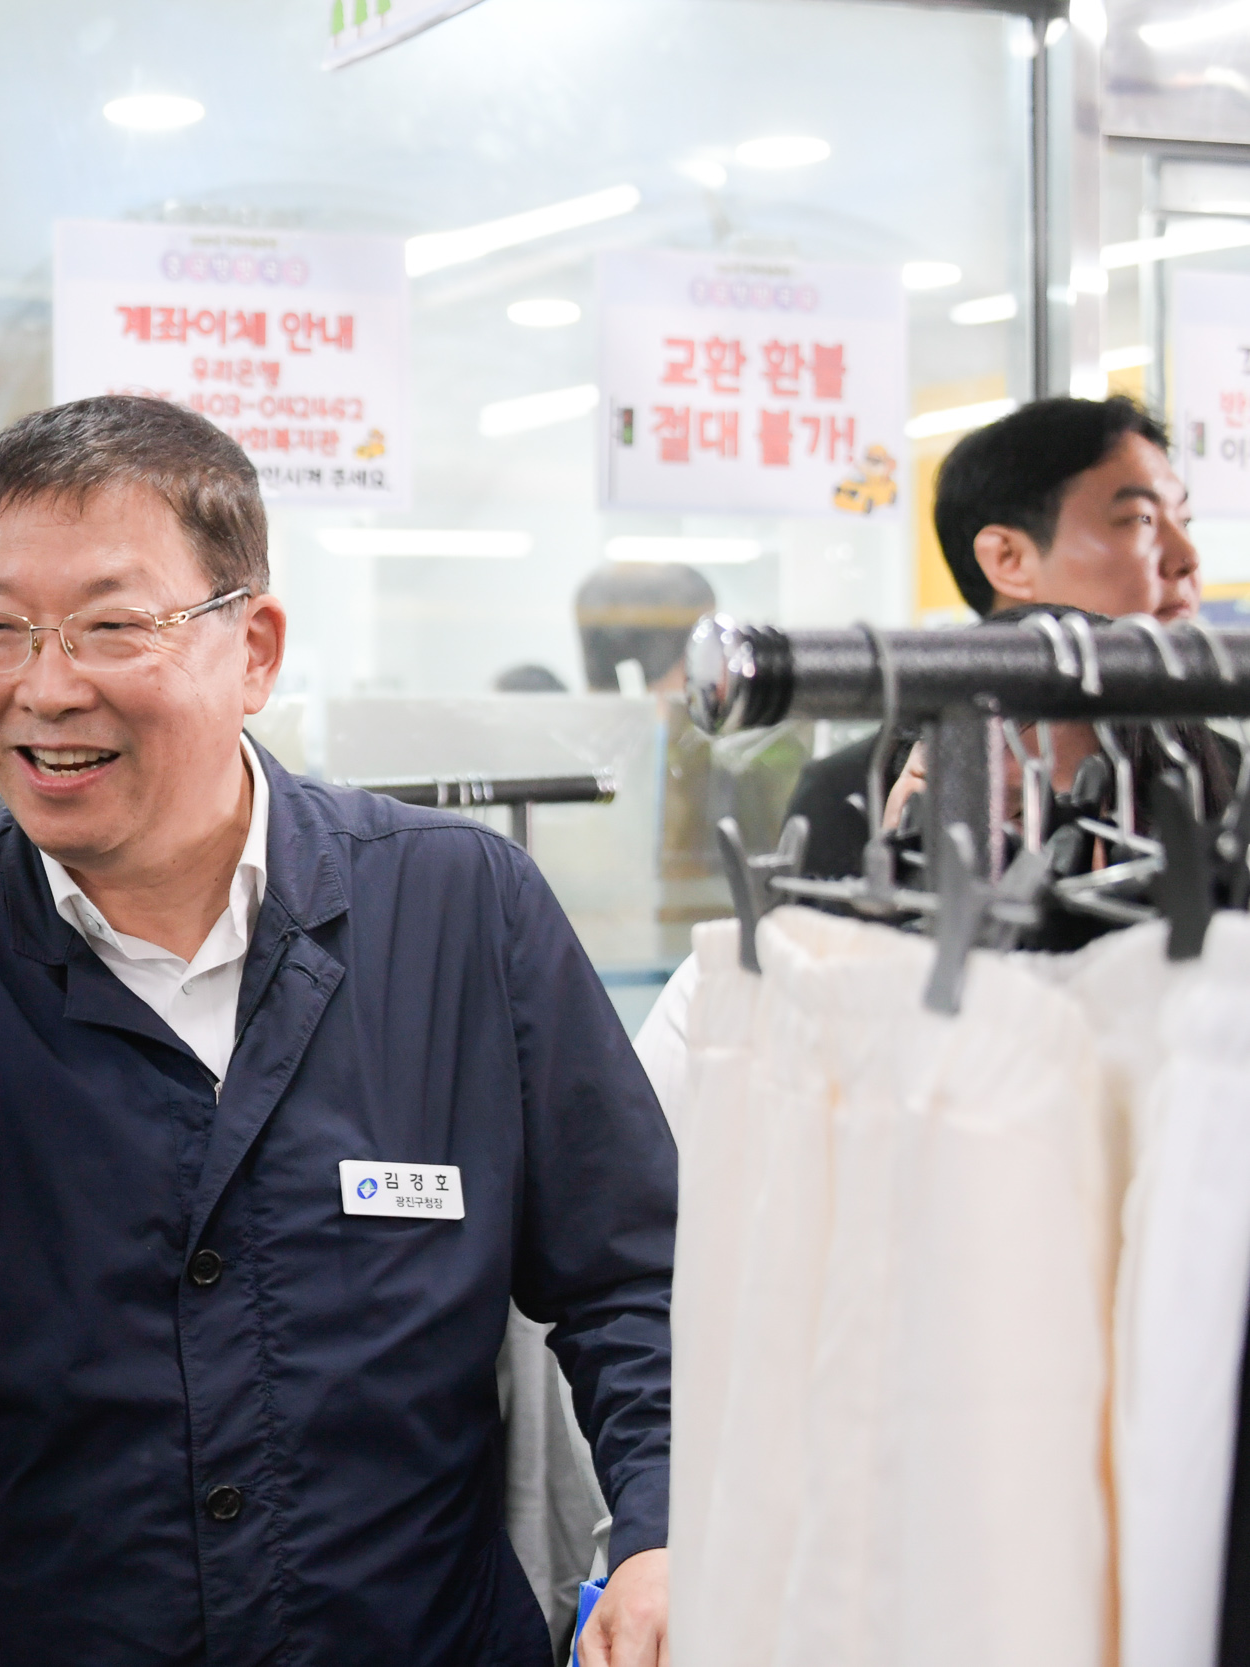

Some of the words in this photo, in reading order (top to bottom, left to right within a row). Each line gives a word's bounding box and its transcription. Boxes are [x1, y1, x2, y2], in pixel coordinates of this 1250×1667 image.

[116, 305, 268, 348] 계좌이체
[280, 312, 355, 354] 안내
[191, 357, 282, 388] 우리은행
[661, 336, 748, 395] 교환
[761, 339, 847, 401] 환불
[652, 405, 740, 463] 절대
[757, 409, 856, 468] 불가!
[395, 1196, 443, 1210] 광진구청장
